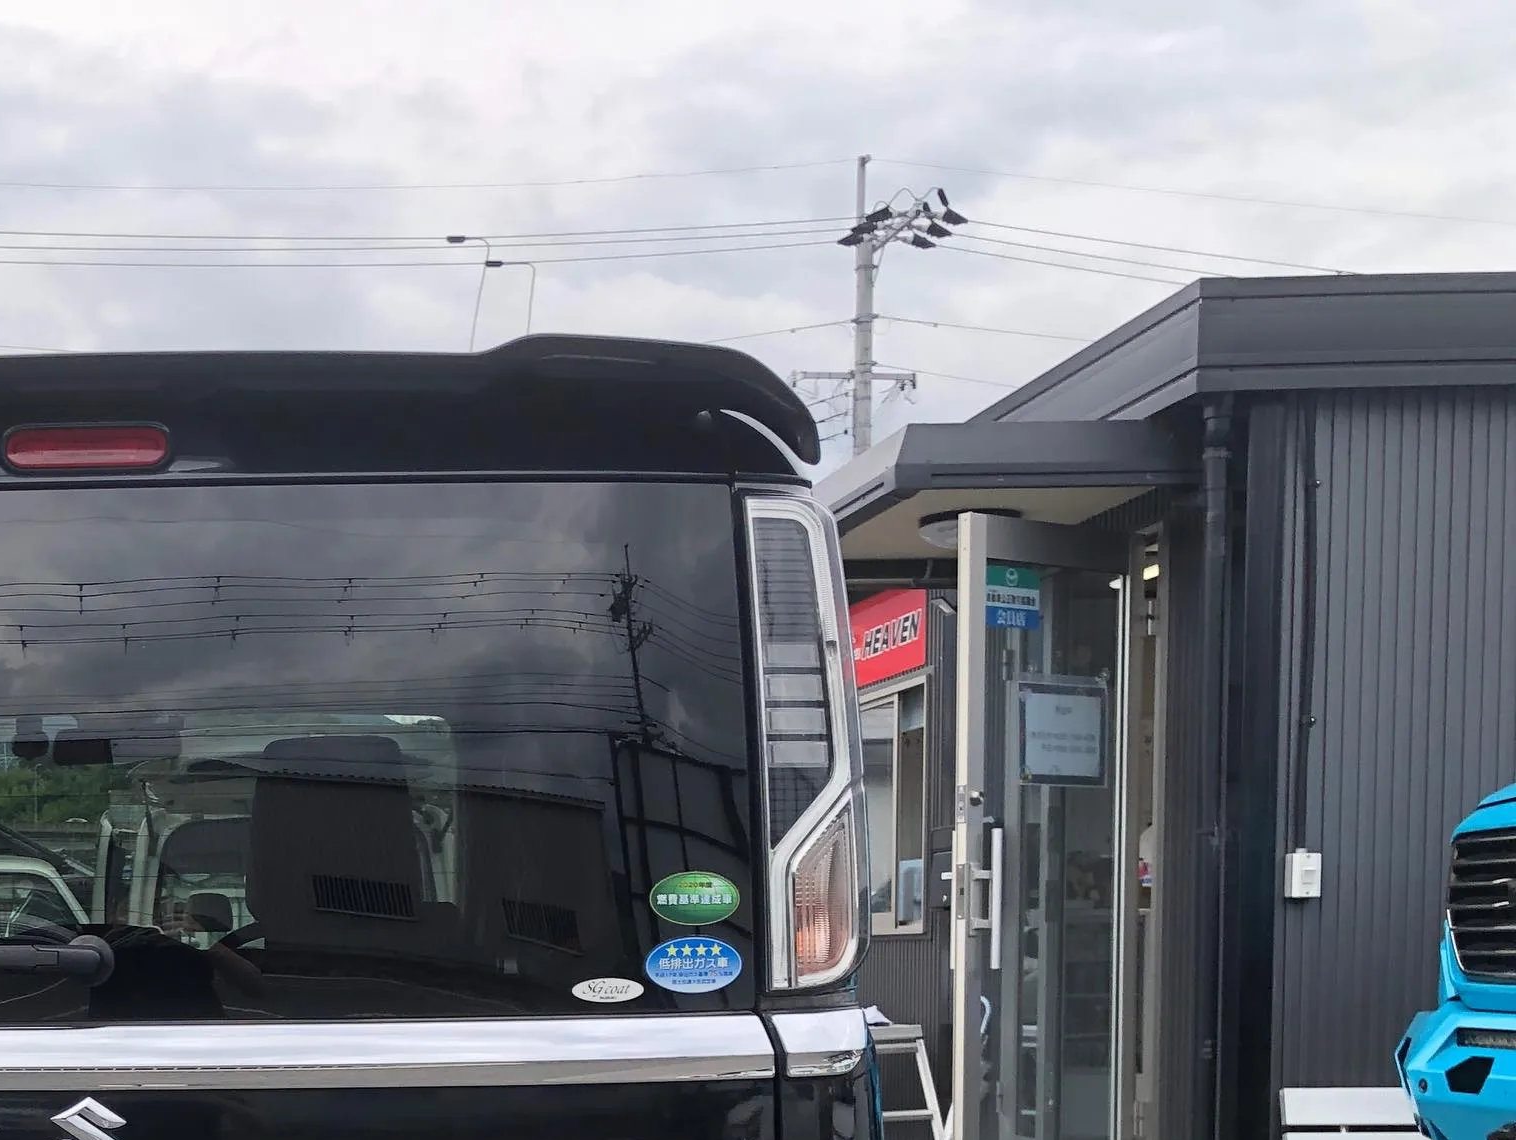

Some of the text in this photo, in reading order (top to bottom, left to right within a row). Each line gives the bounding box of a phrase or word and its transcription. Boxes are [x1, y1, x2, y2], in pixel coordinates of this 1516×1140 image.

[861, 608, 922, 661] HEAVEN
[659, 956, 729, 970] 低排出ガス車
